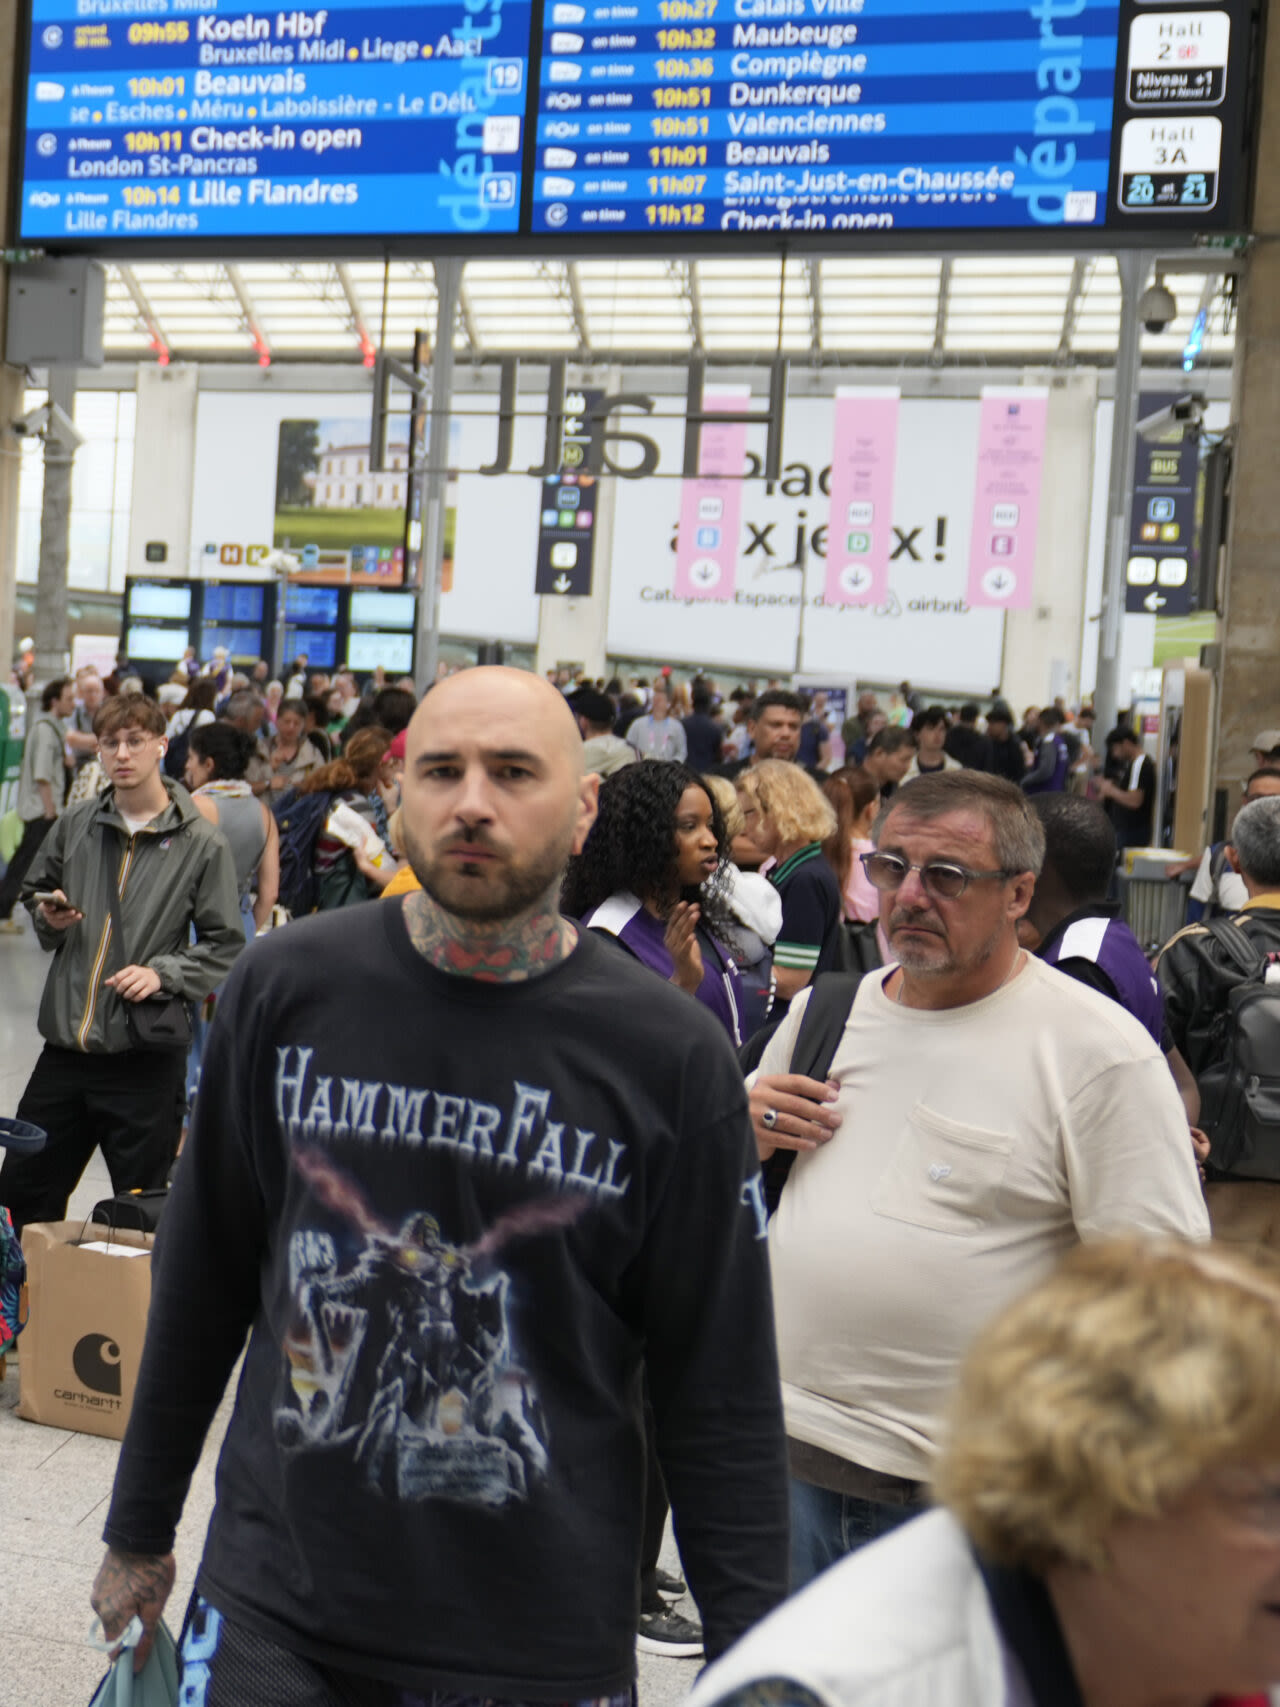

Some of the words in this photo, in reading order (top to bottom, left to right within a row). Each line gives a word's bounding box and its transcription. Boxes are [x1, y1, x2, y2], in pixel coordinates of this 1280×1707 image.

[128, 22, 189, 45] 09h55
[197, 13, 269, 42] Koeln
[276, 9, 328, 39] Hbf
[732, 21, 857, 49] Maubeuge
[1159, 21, 1203, 38] Hall
[657, 28, 716, 50] 10h32
[199, 40, 294, 66] Bruxelles
[299, 38, 345, 61] Midi
[362, 37, 419, 64] Liege
[1157, 43, 1171, 60] 2
[494, 65, 520, 87] 19
[655, 57, 714, 78] 10h36
[731, 50, 867, 80] Compiègne
[127, 76, 185, 98] 10h01
[194, 67, 306, 97] Beauvais
[1136, 71, 1188, 87] Niveau
[1195, 70, 1214, 86] +1
[652, 87, 711, 108] 10h51
[729, 81, 862, 109] Dunkerque
[106, 101, 174, 123] Esches
[190, 98, 244, 120] Méru
[261, 94, 378, 119] Laboissière
[398, 93, 424, 115] Le
[651, 116, 709, 138] 10h51
[727, 110, 886, 136] Valenciennes
[1151, 127, 1195, 141] Hall
[124, 130, 183, 153] 10h11
[190, 124, 296, 151] Check-in
[300, 127, 362, 154] open
[649, 145, 707, 167] 11h01
[725, 139, 830, 165] Beauvais
[1153, 148, 1188, 164] 3A
[68, 155, 144, 178] London
[148, 153, 258, 177] St-Pancras
[189, 179, 241, 205] Lille
[248, 177, 358, 205] Flandres
[486, 180, 512, 202] 13
[647, 174, 707, 196] 11h07
[723, 166, 1015, 195] Saint-Just-en-Chaussée
[122, 186, 180, 206] 10h14
[1126, 182, 1155, 204] 20
[1180, 181, 1209, 204] 21
[65, 209, 107, 231] Lille
[113, 208, 199, 230] Flandres
[646, 203, 705, 225] 11h12
[1150, 458, 1178, 475] BUS
[907, 594, 970, 614] airbnb
[54, 1389, 122, 1410] carhartt
